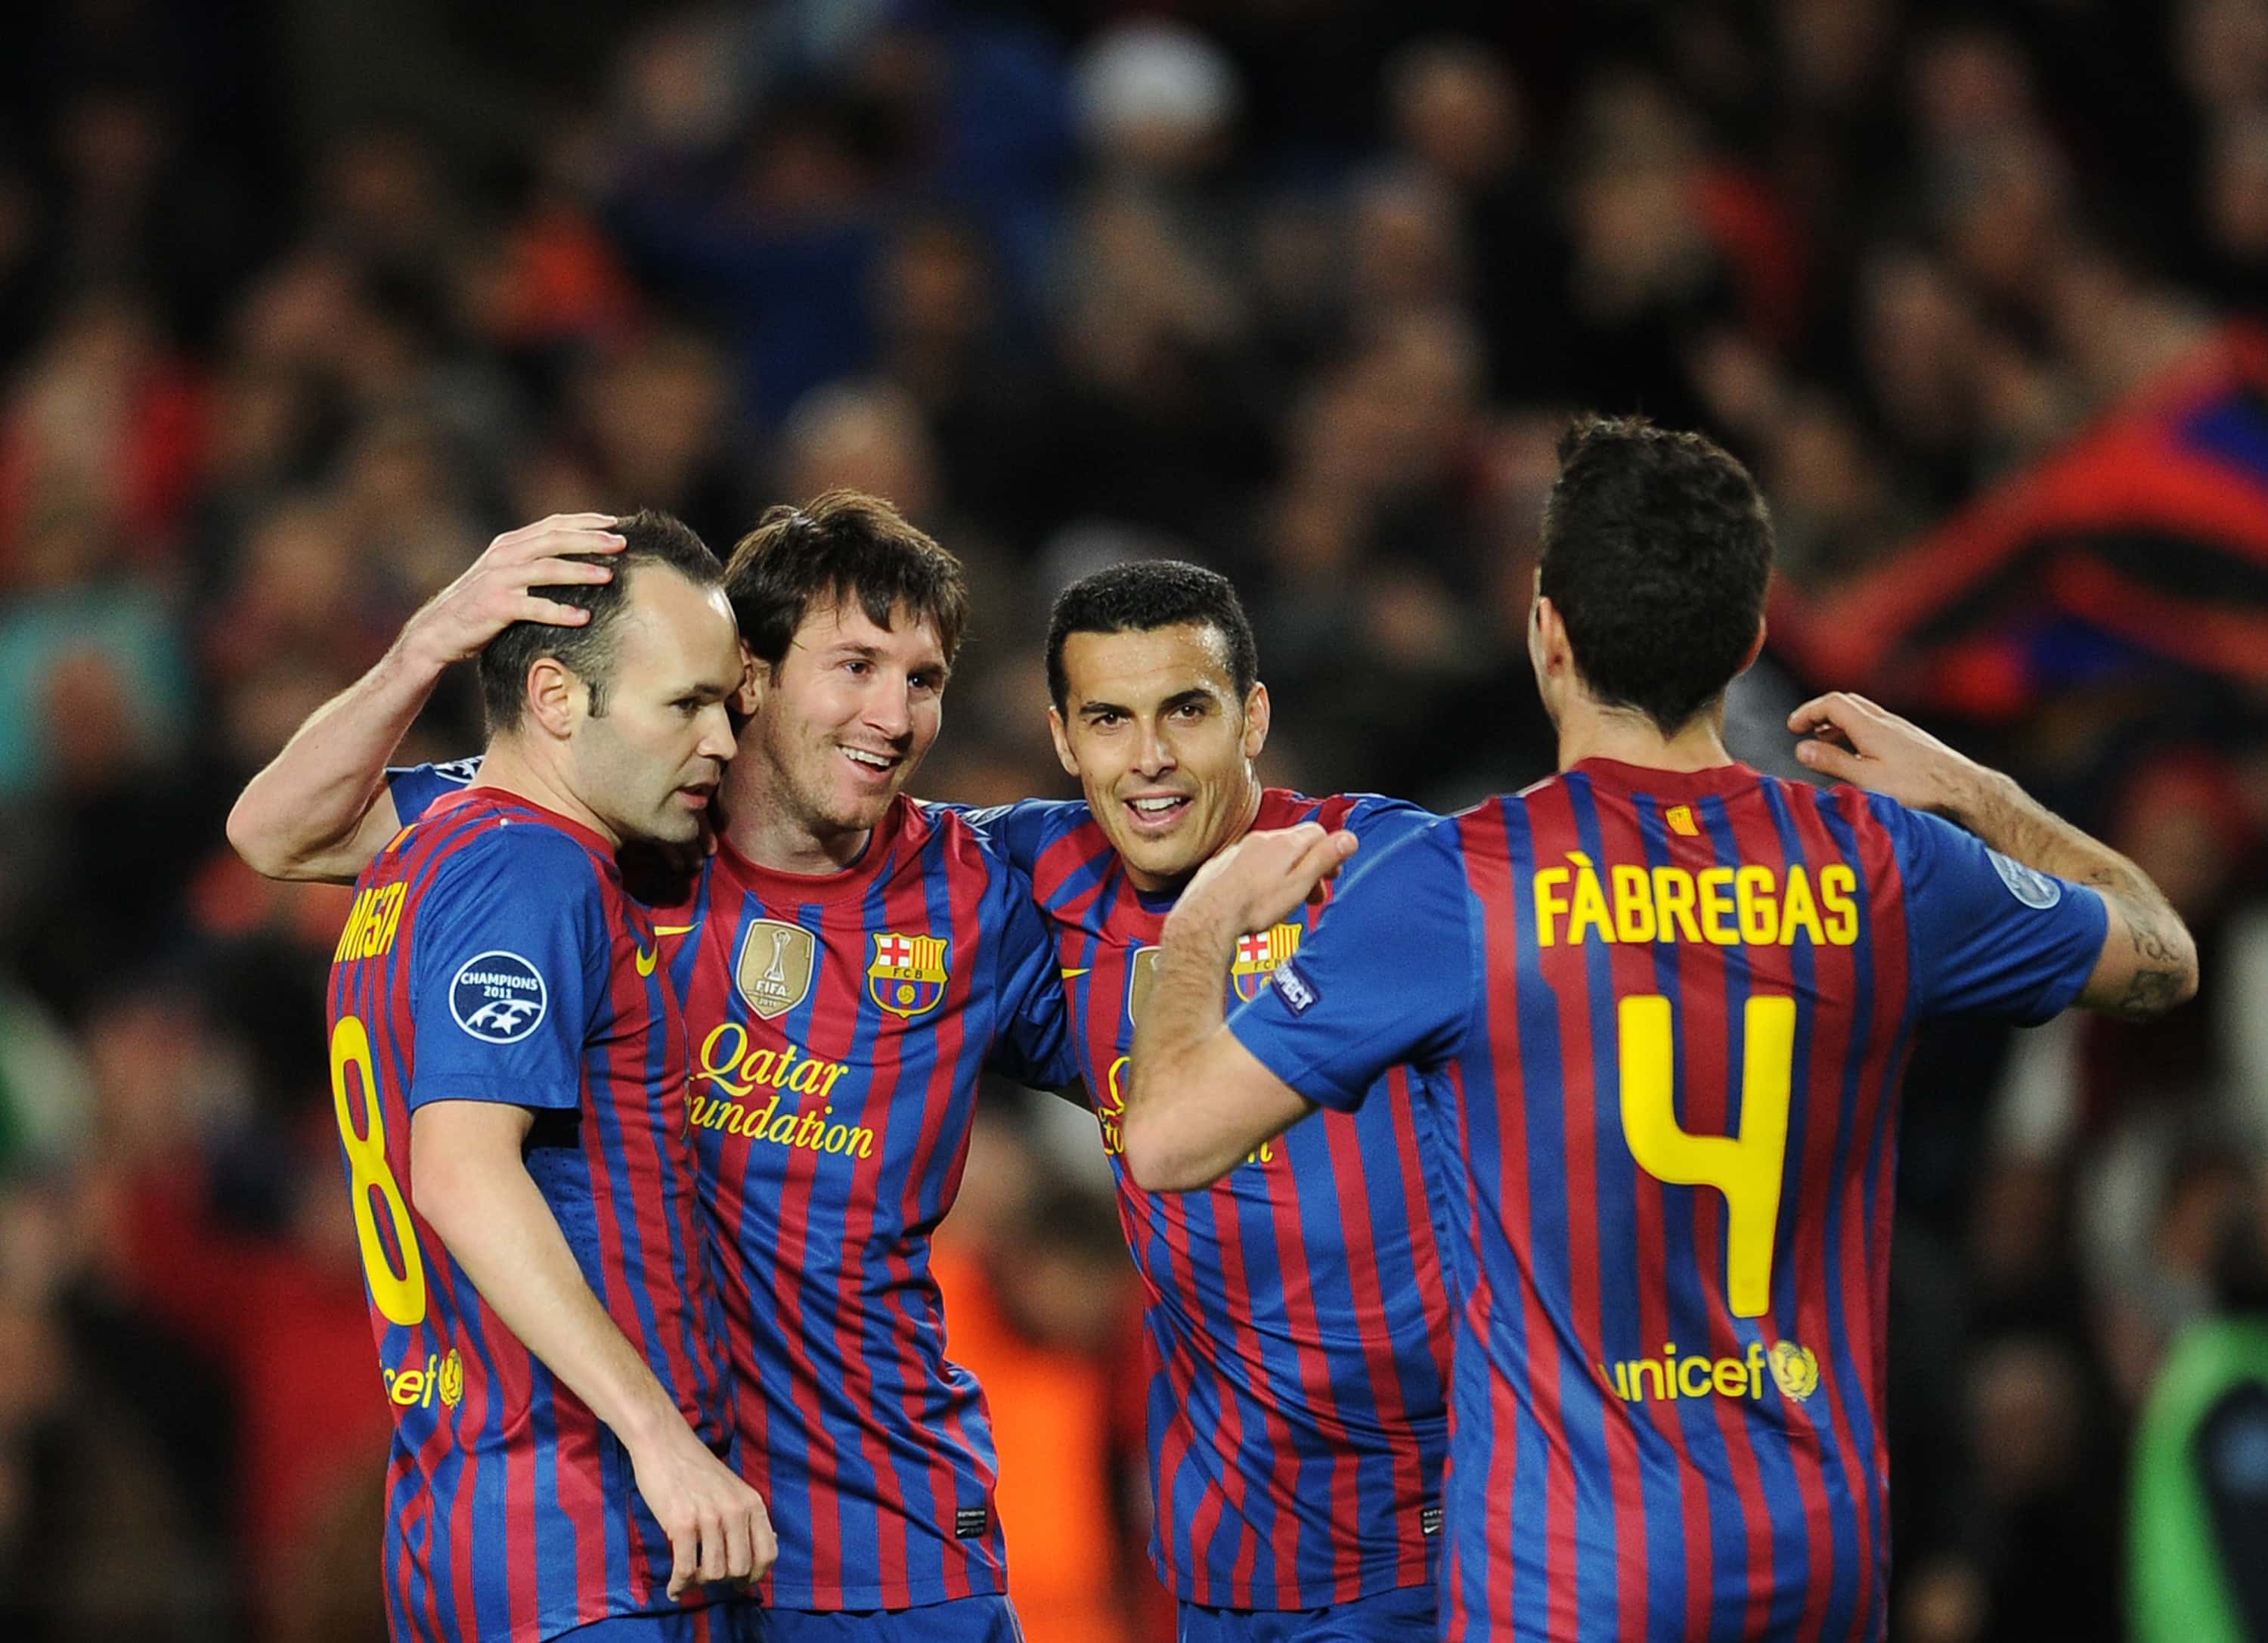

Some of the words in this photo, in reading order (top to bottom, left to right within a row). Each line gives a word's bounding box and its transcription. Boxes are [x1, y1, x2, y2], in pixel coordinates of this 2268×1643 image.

[1534, 851, 1859, 947] FÀBREGAS
[460, 972, 538, 991] CHAMPIONS
[484, 986, 512, 999] 2011
[756, 980, 786, 997] FIFA
[696, 1023, 849, 1096] Qatar
[684, 1096, 874, 1158] undation
[1618, 995, 1796, 1318] 4
[330, 1015, 426, 1325] 8
[1597, 1343, 1766, 1402] unicef
